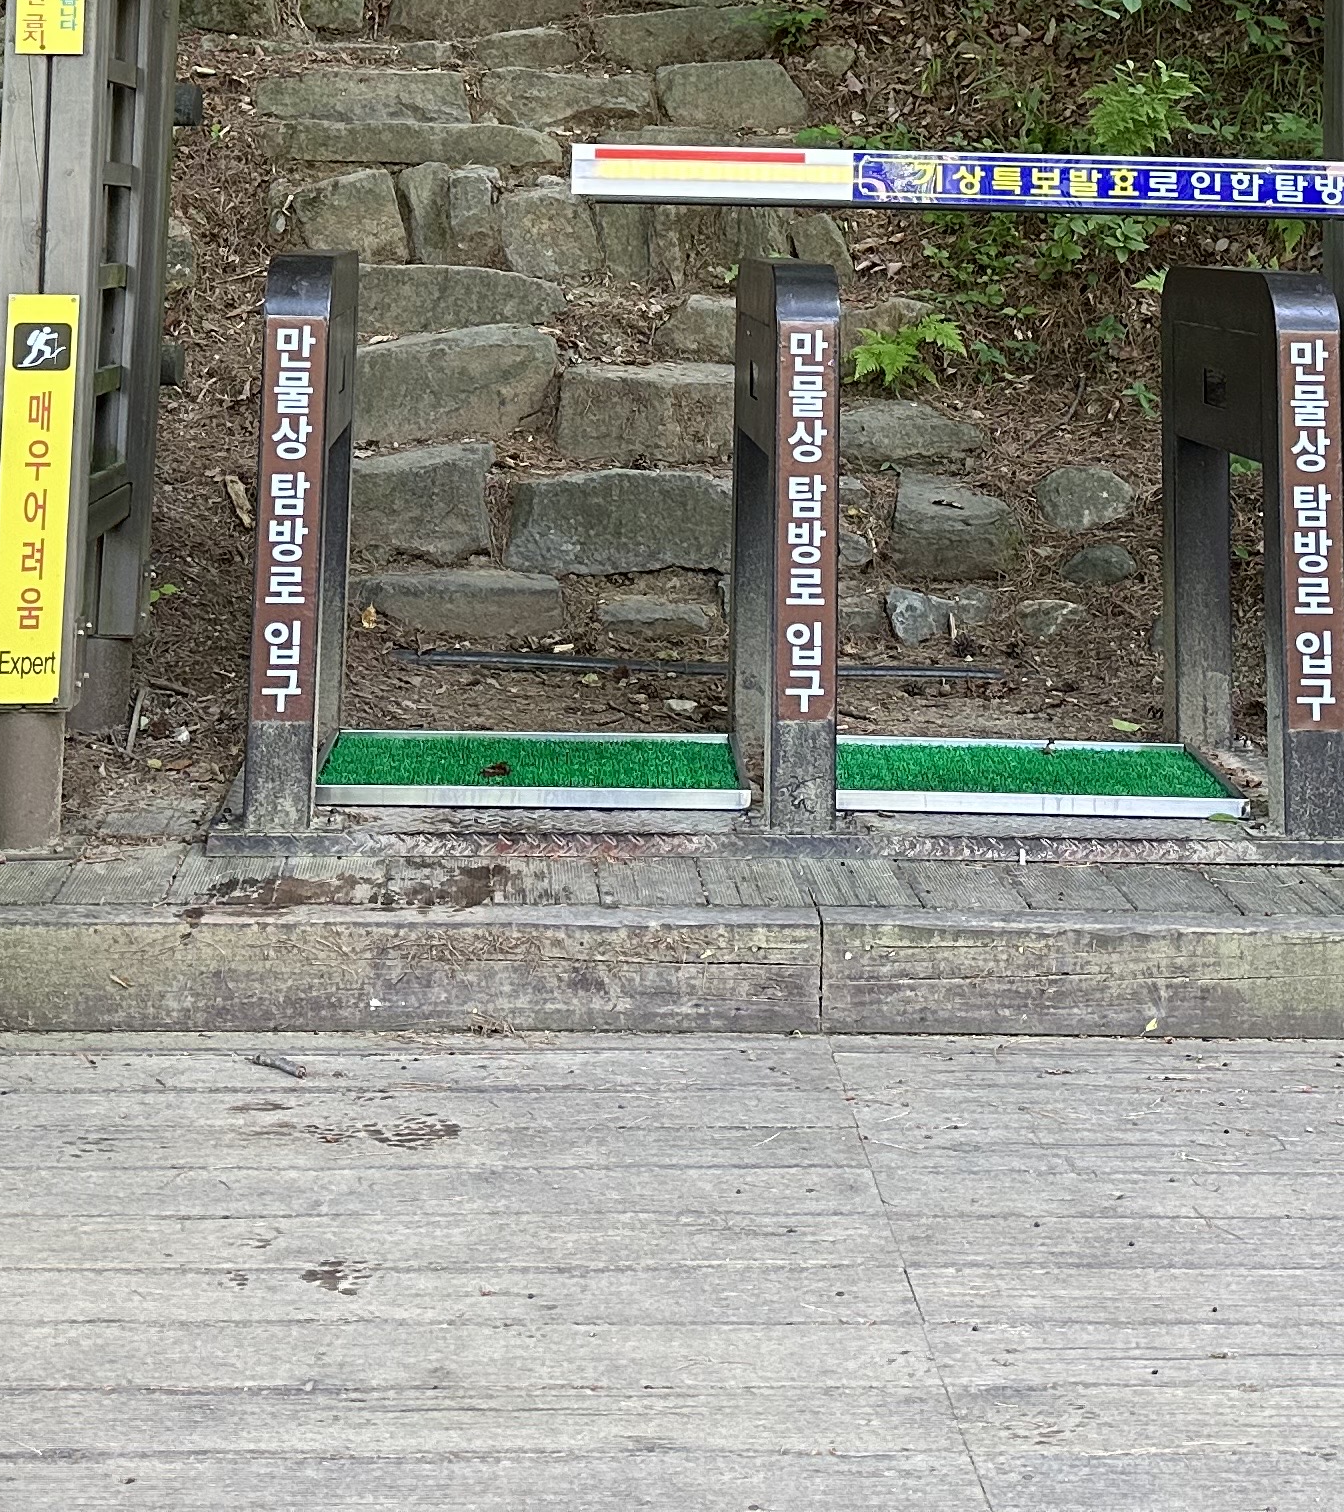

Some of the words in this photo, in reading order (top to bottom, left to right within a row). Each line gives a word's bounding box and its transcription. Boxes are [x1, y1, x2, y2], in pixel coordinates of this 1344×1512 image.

[22, 14, 47, 47] 금지
[272, 325, 317, 460] 만물상
[787, 329, 829, 464] 만물상
[1289, 339, 1331, 473] 만물상
[264, 471, 311, 605] 탐방로
[785, 474, 827, 606] 탐방로
[1293, 483, 1334, 615] 탐방로
[0, 650, 56, 679] Expert
[261, 620, 302, 713] 입구
[785, 621, 825, 714] 입구
[1295, 630, 1336, 722] 입구
